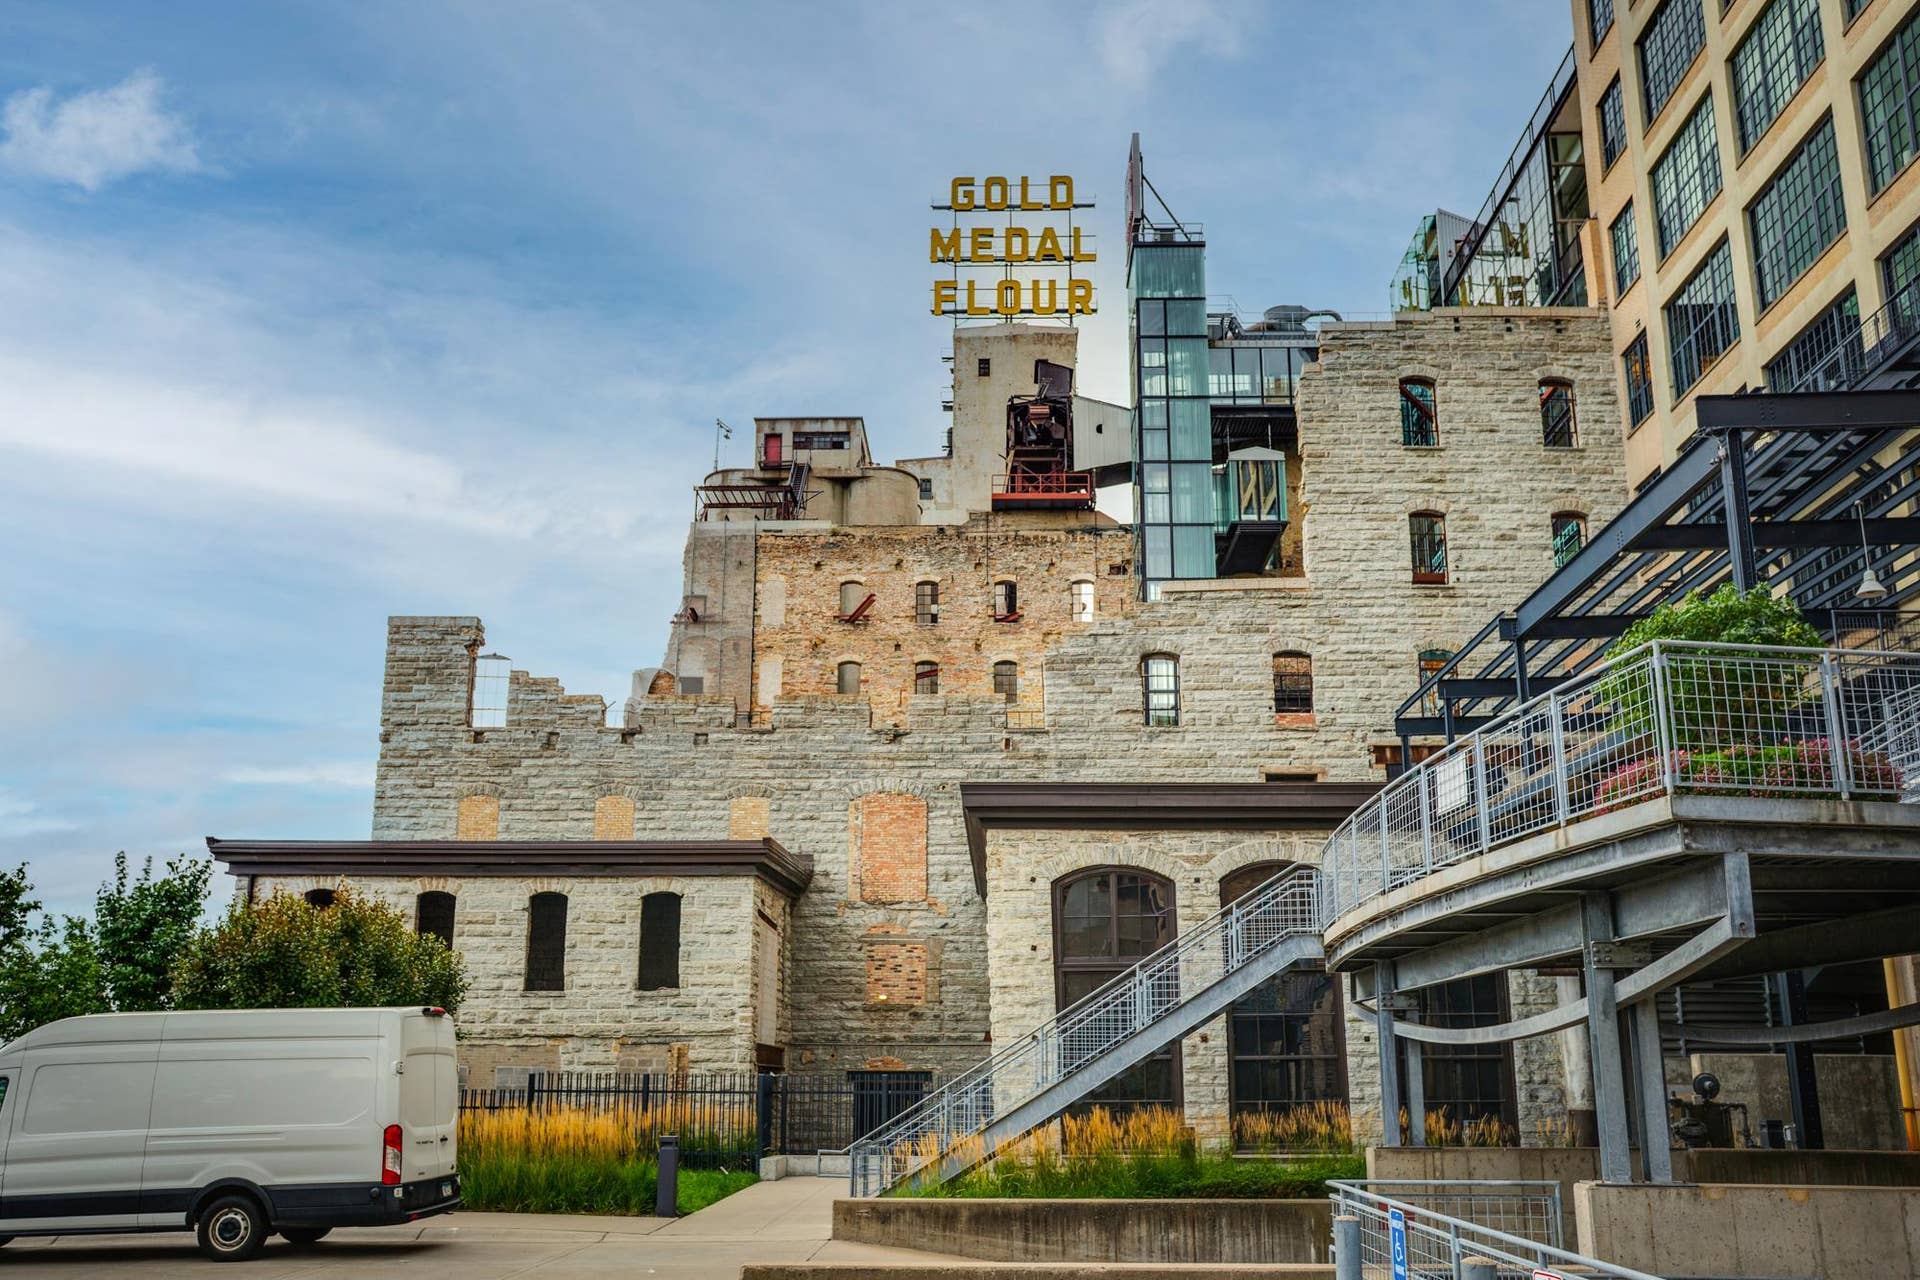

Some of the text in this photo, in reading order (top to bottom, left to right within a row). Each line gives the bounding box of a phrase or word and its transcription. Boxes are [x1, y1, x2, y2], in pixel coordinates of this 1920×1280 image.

[951, 175, 1073, 210] GOLD
[930, 227, 1096, 263] MEDAL
[933, 279, 1093, 315] FLOUR
